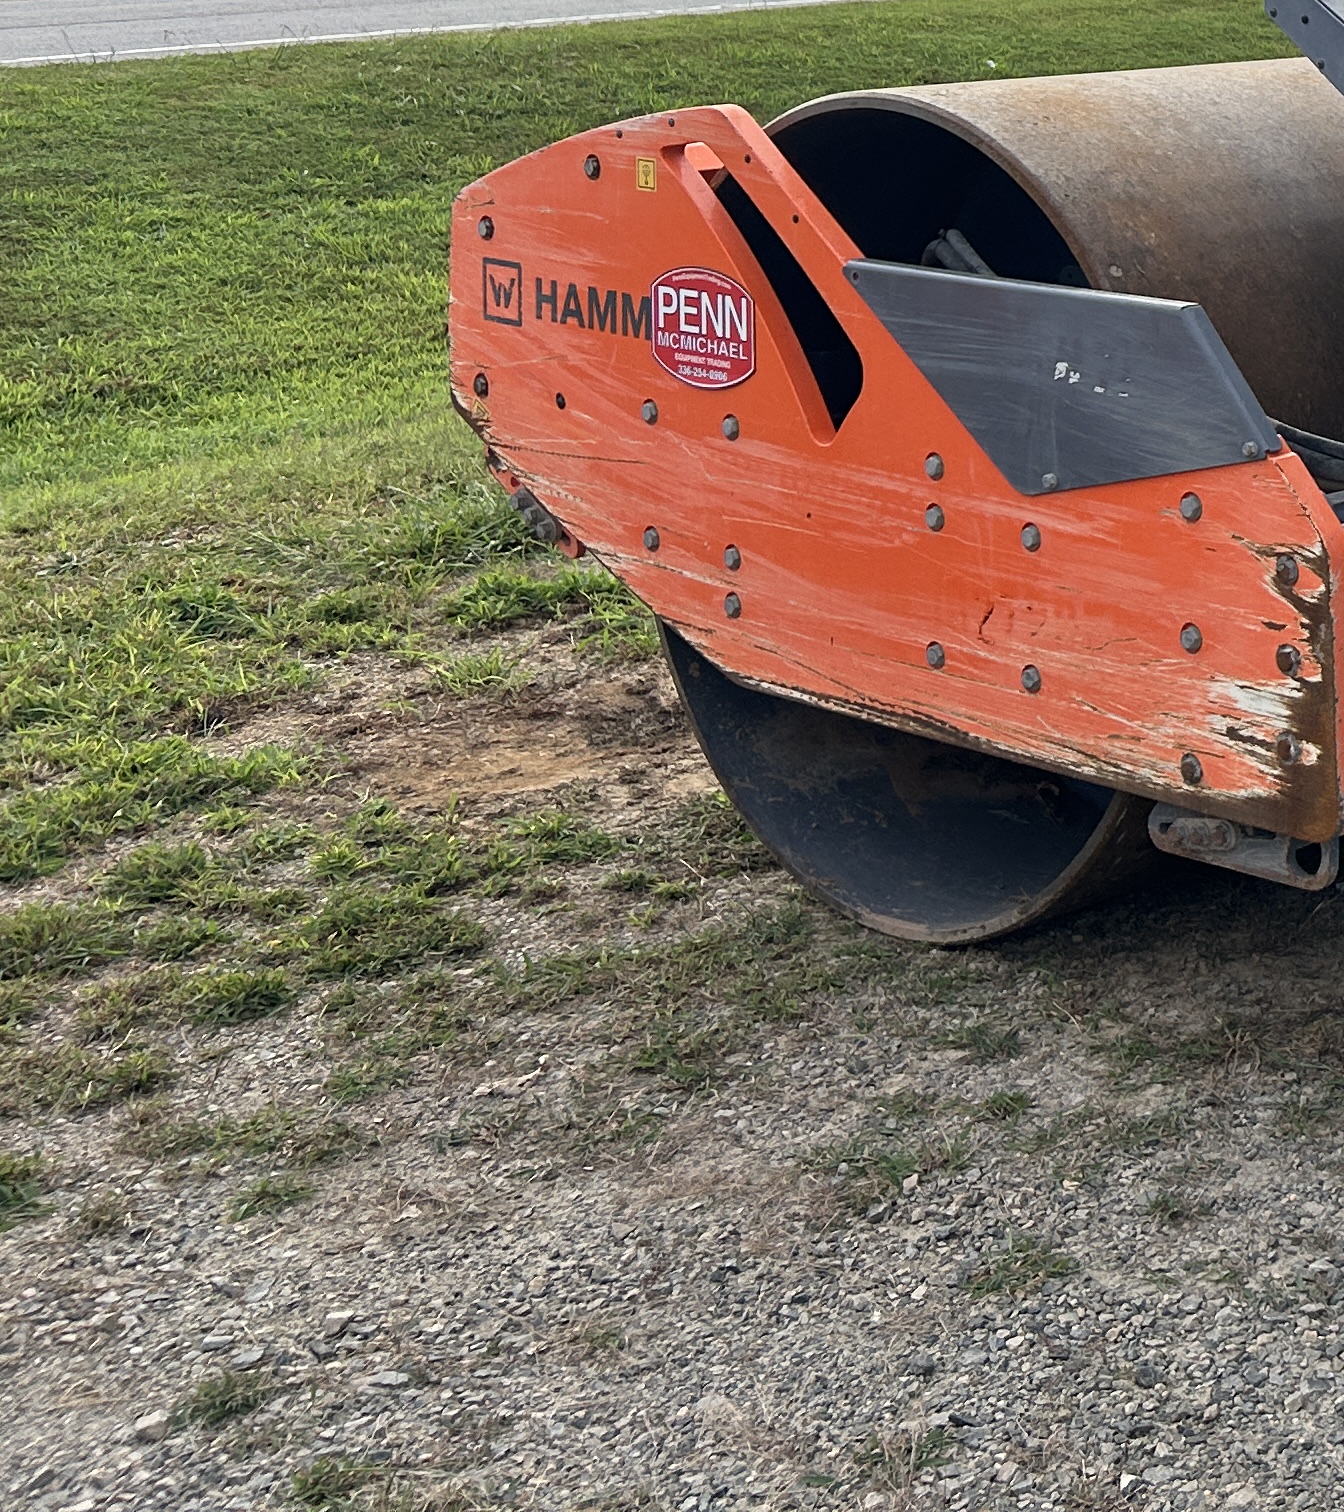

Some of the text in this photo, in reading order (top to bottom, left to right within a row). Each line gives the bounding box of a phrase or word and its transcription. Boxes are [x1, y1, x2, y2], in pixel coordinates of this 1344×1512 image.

[535, 276, 652, 341] HAMM
[657, 285, 748, 342] PENN
[657, 331, 748, 360] MCMICHAEL
